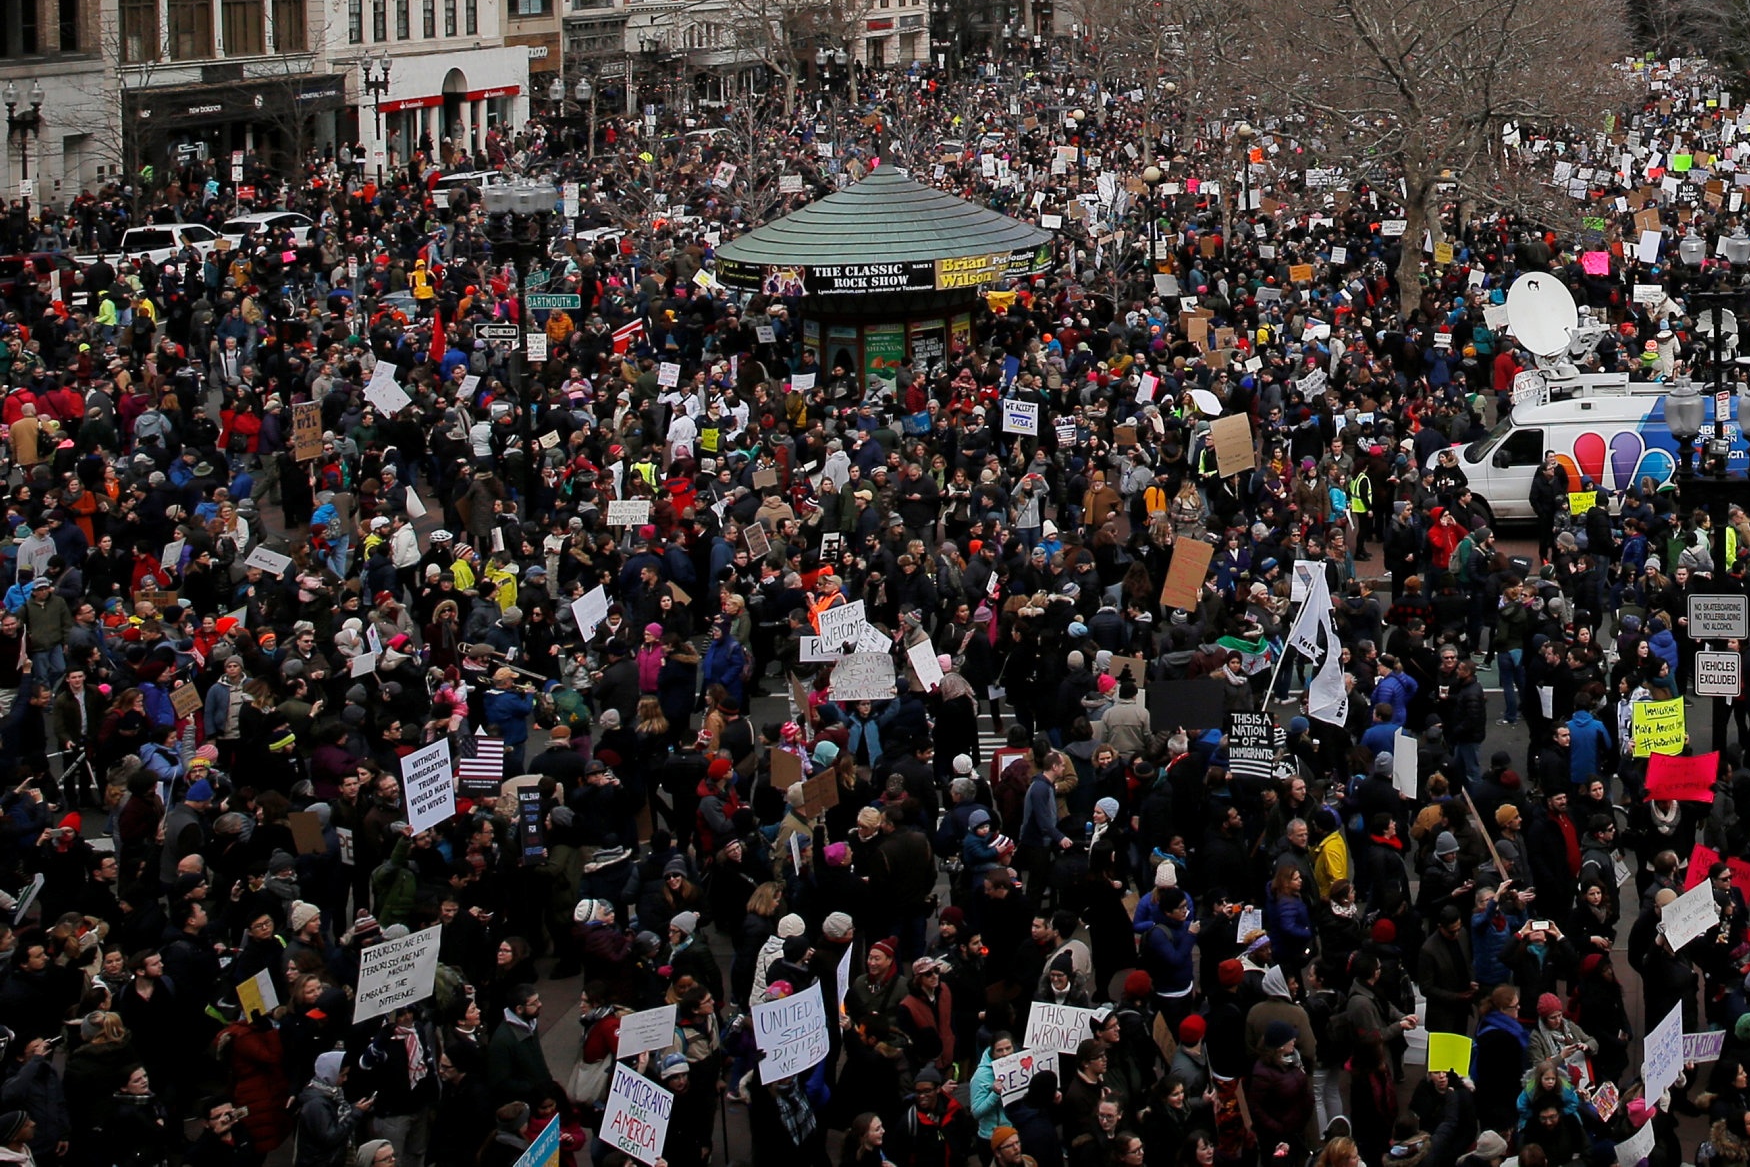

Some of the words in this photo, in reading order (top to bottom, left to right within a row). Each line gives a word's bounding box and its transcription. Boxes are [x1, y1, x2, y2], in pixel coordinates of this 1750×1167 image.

[813, 267, 841, 278] THE
[845, 264, 903, 277] CLASSIC
[941, 257, 987, 273] Brian
[834, 277, 868, 288] ROCK
[871, 275, 910, 286] SHOW
[940, 272, 992, 287] Wilson
[527, 297, 572, 307] DARTMOUTH
[488, 328, 501, 336] ONE
[502, 328, 515, 336] WAY
[1515, 378, 1531, 391] NOT
[1005, 402, 1015, 411] WE
[1015, 403, 1036, 413] ACCEPT
[1703, 603, 1741, 611] SKATEBOARDING
[820, 605, 859, 627] REFUGEES
[1695, 613, 1702, 621] NO
[1703, 613, 1741, 621] ROLLERBLADING
[823, 616, 865, 647] WELCOME
[1701, 661, 1736, 672] VEHICLES
[1700, 674, 1736, 685] EXCLUDED
[1231, 713, 1250, 724] THIS
[1263, 714, 1272, 725] A
[1232, 725, 1266, 737] NATION
[1635, 724, 1651, 735] Make
[1242, 737, 1256, 745] OF
[412, 750, 440, 769] WITHOUT
[1229, 747, 1273, 760] IMMIGRANTS
[407, 758, 449, 784] IMMIGRATION
[418, 773, 440, 790] TRUMP
[411, 789, 433, 806] WOULD
[434, 780, 451, 797] HAVE
[417, 805, 427, 816] NO
[428, 794, 447, 812] WIVES
[363, 943, 402, 964] TERRORISTS
[403, 938, 416, 952] ARE
[417, 932, 433, 947] EVIL
[361, 956, 400, 978] TERRORISTS
[400, 952, 413, 966] ARE
[412, 946, 428, 961] NOT
[387, 962, 416, 980] MUSLIM
[360, 984, 391, 1003] EMBRACE
[395, 978, 408, 991] THE
[760, 1003, 814, 1035] UNITED
[1038, 1005, 1064, 1026] THIS
[1073, 1011, 1086, 1030] IS
[1031, 1023, 1082, 1050] WRONG!
[779, 1059, 798, 1074] WE
[612, 1070, 673, 1122] IMMIGRANTS
[628, 1102, 648, 1122] MAKE
[610, 1110, 657, 1153] AMERICA
[617, 1136, 643, 1159] GREAT!
